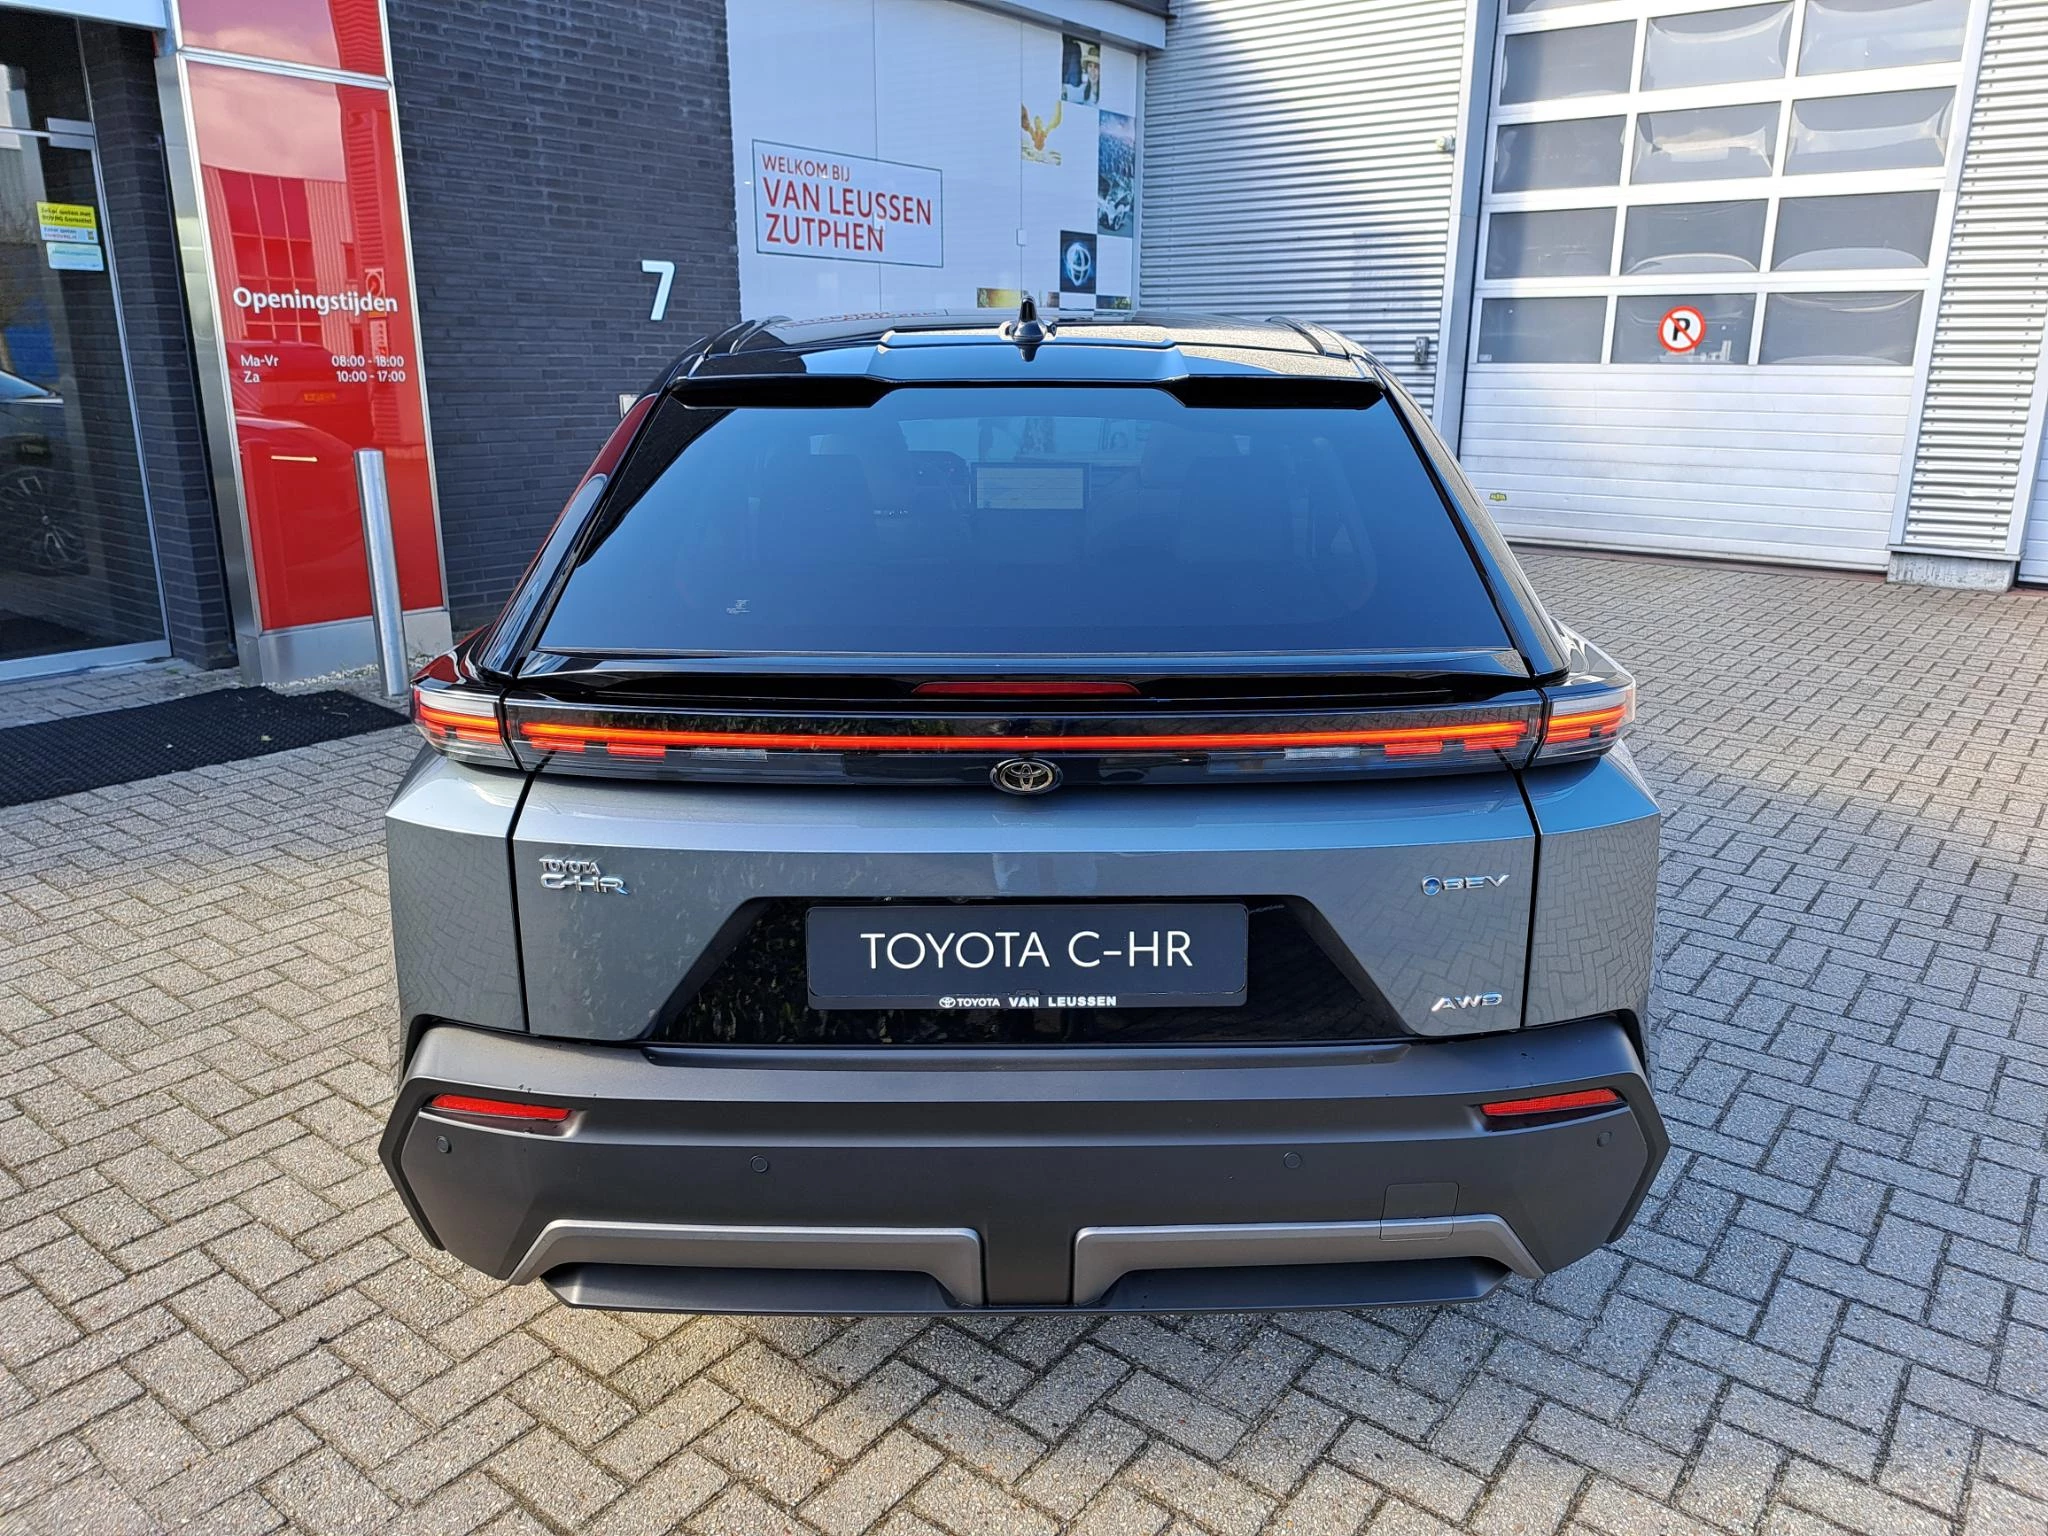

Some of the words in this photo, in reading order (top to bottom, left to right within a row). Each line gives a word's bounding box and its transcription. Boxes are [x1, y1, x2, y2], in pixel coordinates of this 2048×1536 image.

[762, 153, 828, 178] WELKOM
[832, 164, 850, 182] BIJ
[763, 176, 820, 212] VAN
[829, 186, 932, 226] LEUSSEN
[766, 212, 884, 253] ZUTPHEN
[233, 287, 398, 316] Openingstijden
[641, 259, 675, 321] 7
[1672, 317, 1690, 341] P
[240, 354, 279, 367] Ma-Vr
[331, 355, 365, 367] 08:00
[376, 355, 404, 367] 18:00
[243, 370, 260, 383] Za
[336, 370, 367, 382] 10:00
[378, 370, 406, 382] 17:00
[539, 858, 600, 875] TOYOTA
[541, 873, 629, 895] C-HR
[1442, 874, 1510, 891] BEV
[860, 931, 1050, 970] TOYOTA
[1068, 930, 1193, 968] C-HR
[957, 997, 1000, 1008] TOYOTA
[1008, 996, 1039, 1008] VAN
[1048, 995, 1117, 1008] LEUSSEN
[1431, 991, 1503, 1012] AWD
